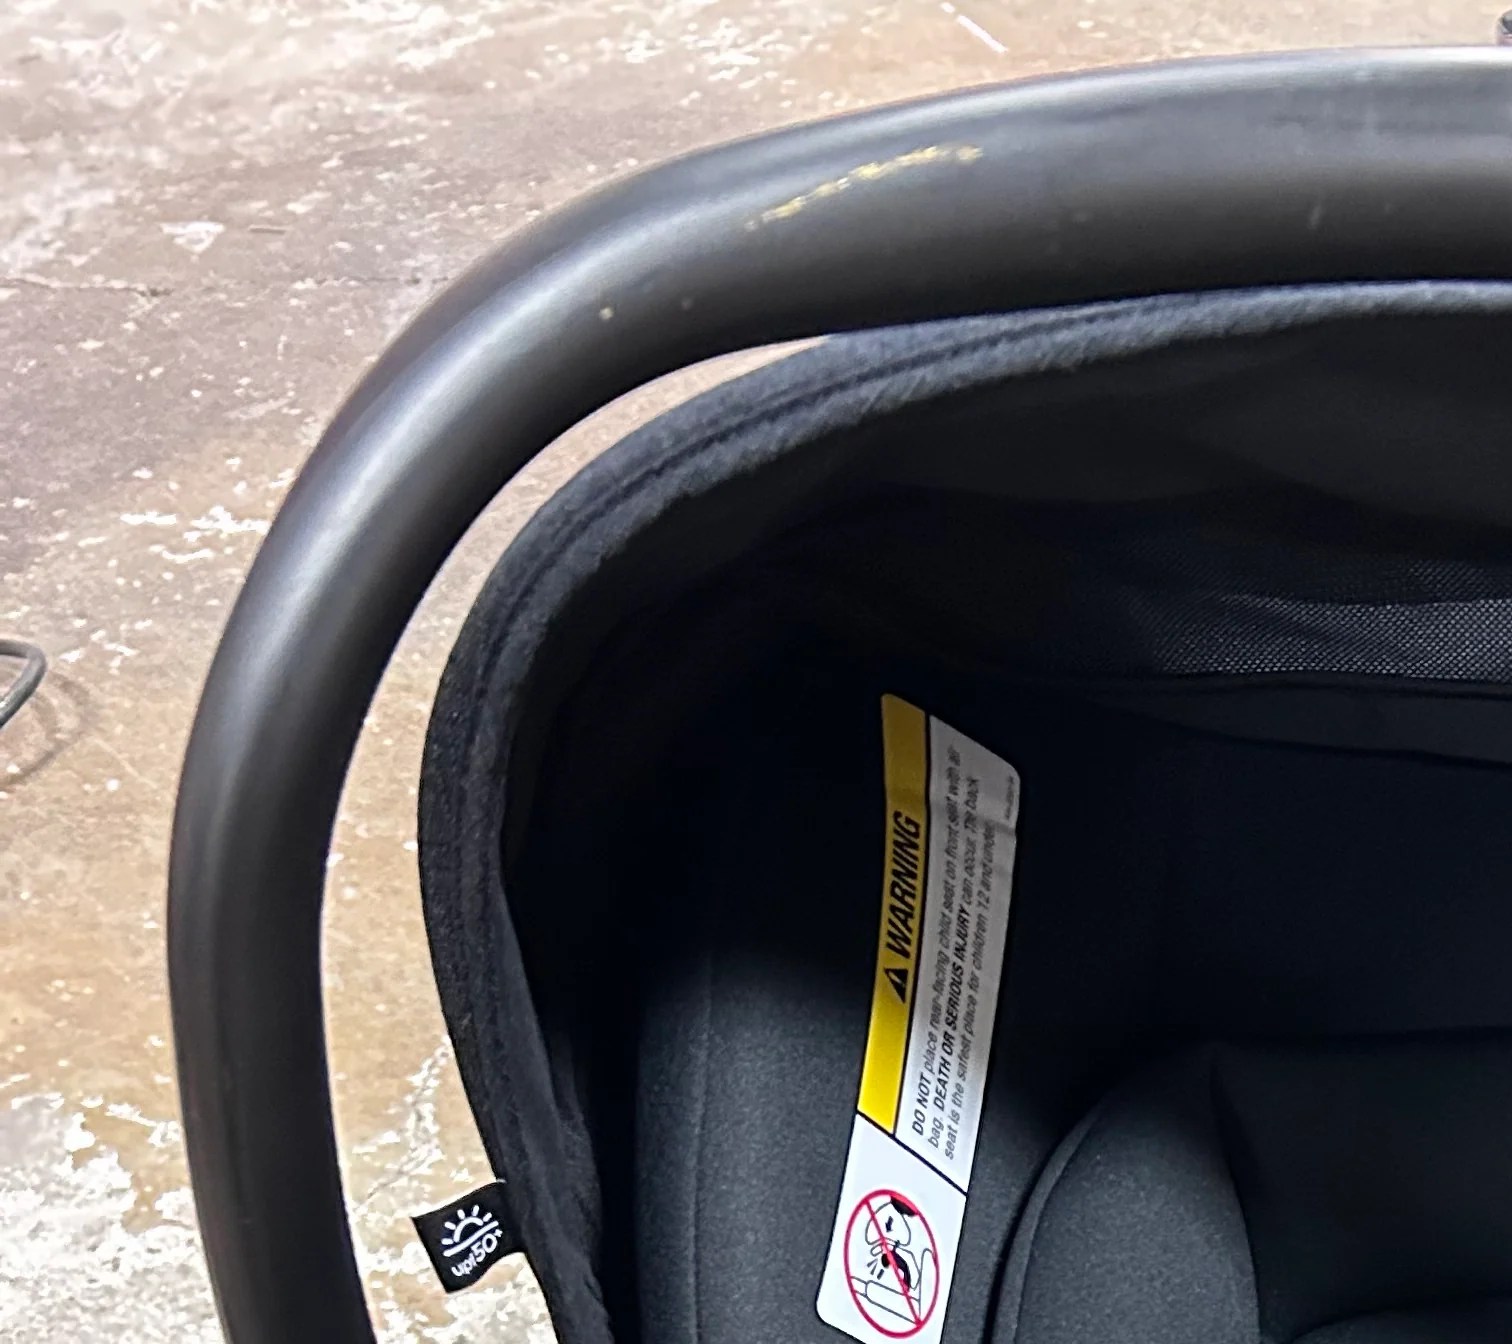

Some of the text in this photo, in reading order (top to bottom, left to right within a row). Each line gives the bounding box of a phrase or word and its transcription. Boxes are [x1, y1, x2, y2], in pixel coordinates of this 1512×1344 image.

[944, 825, 959, 859] front
[885, 810, 921, 959] WARNING
[961, 878, 974, 905] can
[980, 860, 993, 890] and
[942, 880, 956, 913] seat
[976, 888, 990, 910] 12
[937, 911, 952, 949] child
[953, 903, 970, 963] INJURY
[971, 912, 988, 970] children
[929, 950, 950, 1031] rear-facing
[944, 961, 964, 1031] SERIOUS
[967, 969, 981, 993] for
[962, 993, 978, 1037] place
[923, 1031, 938, 1076] place
[941, 1031, 956, 1056] OR
[956, 1034, 972, 1082] safest
[915, 1071, 931, 1109] NOT
[932, 1056, 951, 1112] DEATH
[951, 1082, 965, 1109] the
[911, 1108, 926, 1136] DO
[928, 1116, 945, 1149] bag.
[948, 1108, 961, 1125] is
[944, 1124, 958, 1161] seat
